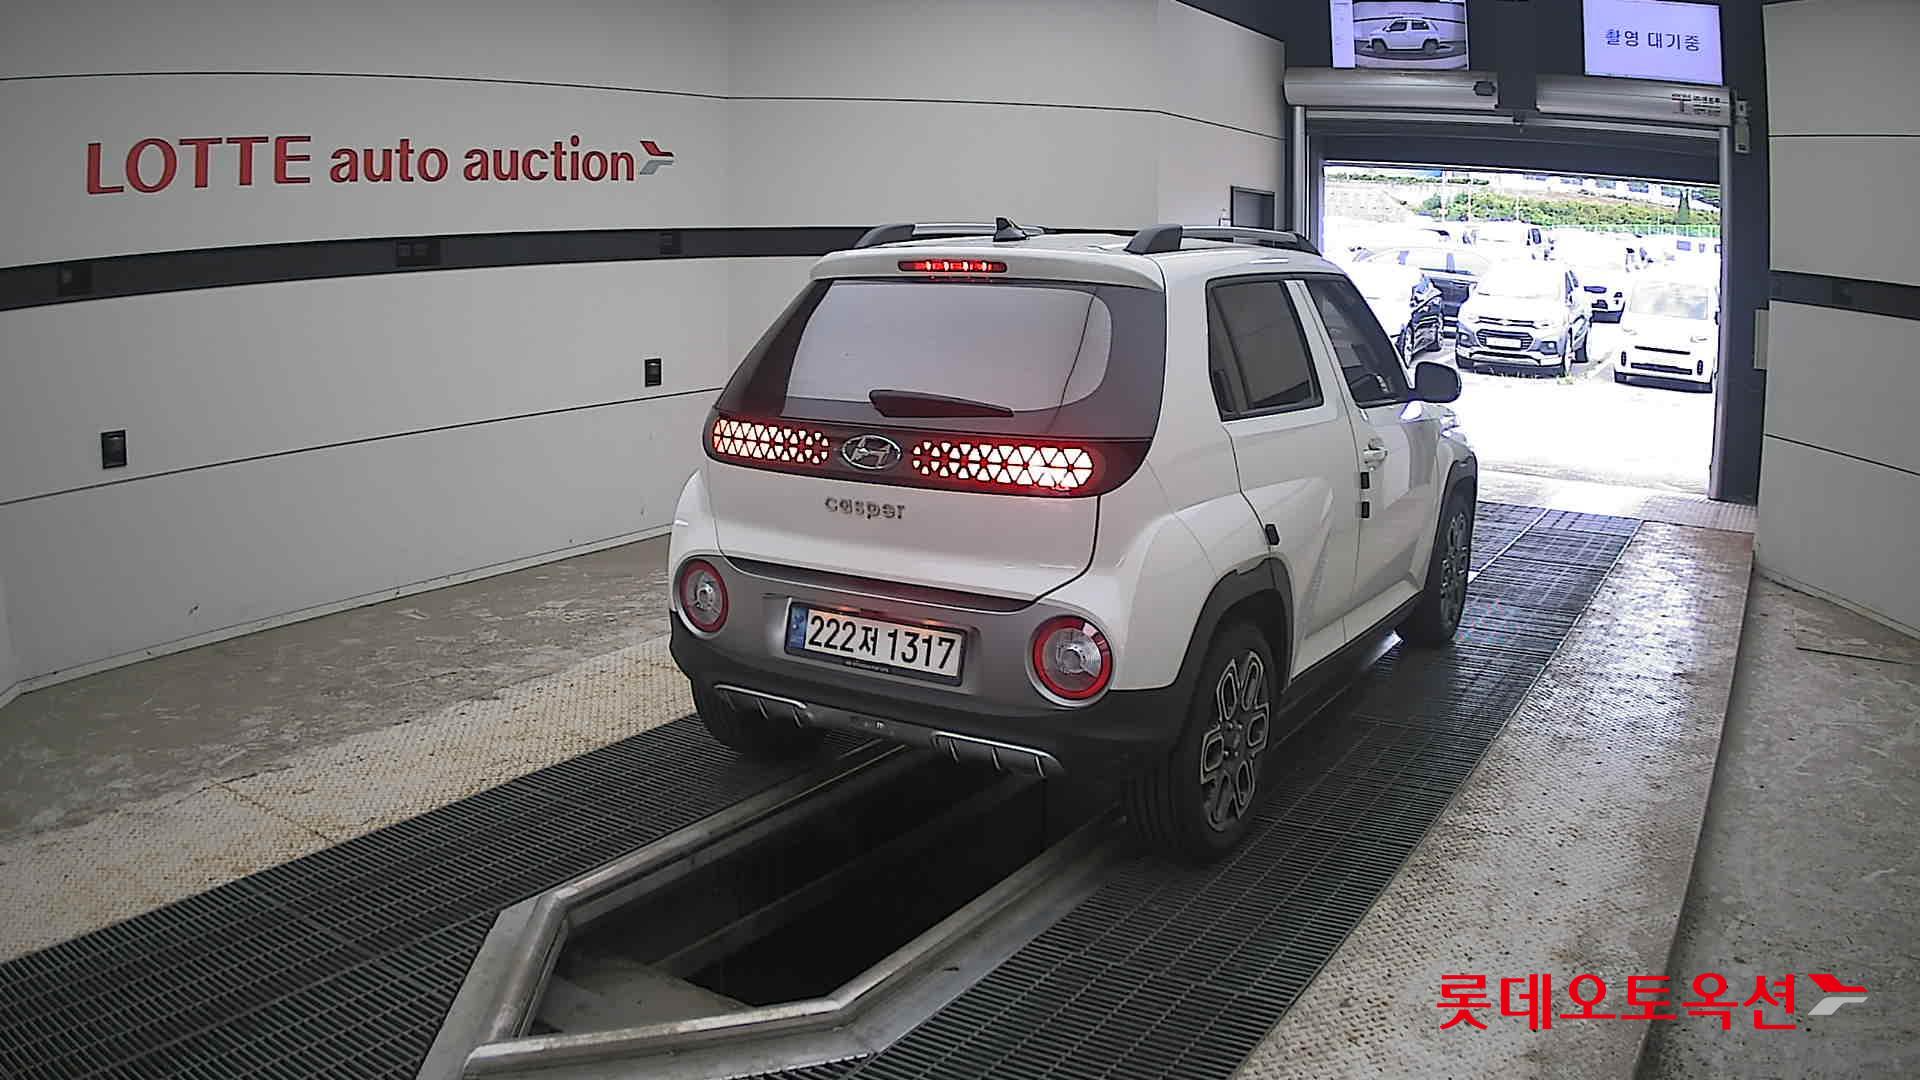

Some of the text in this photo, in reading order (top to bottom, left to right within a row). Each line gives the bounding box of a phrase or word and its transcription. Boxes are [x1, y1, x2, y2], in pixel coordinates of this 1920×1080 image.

[87, 135, 636, 195] LOTTE auto auction
